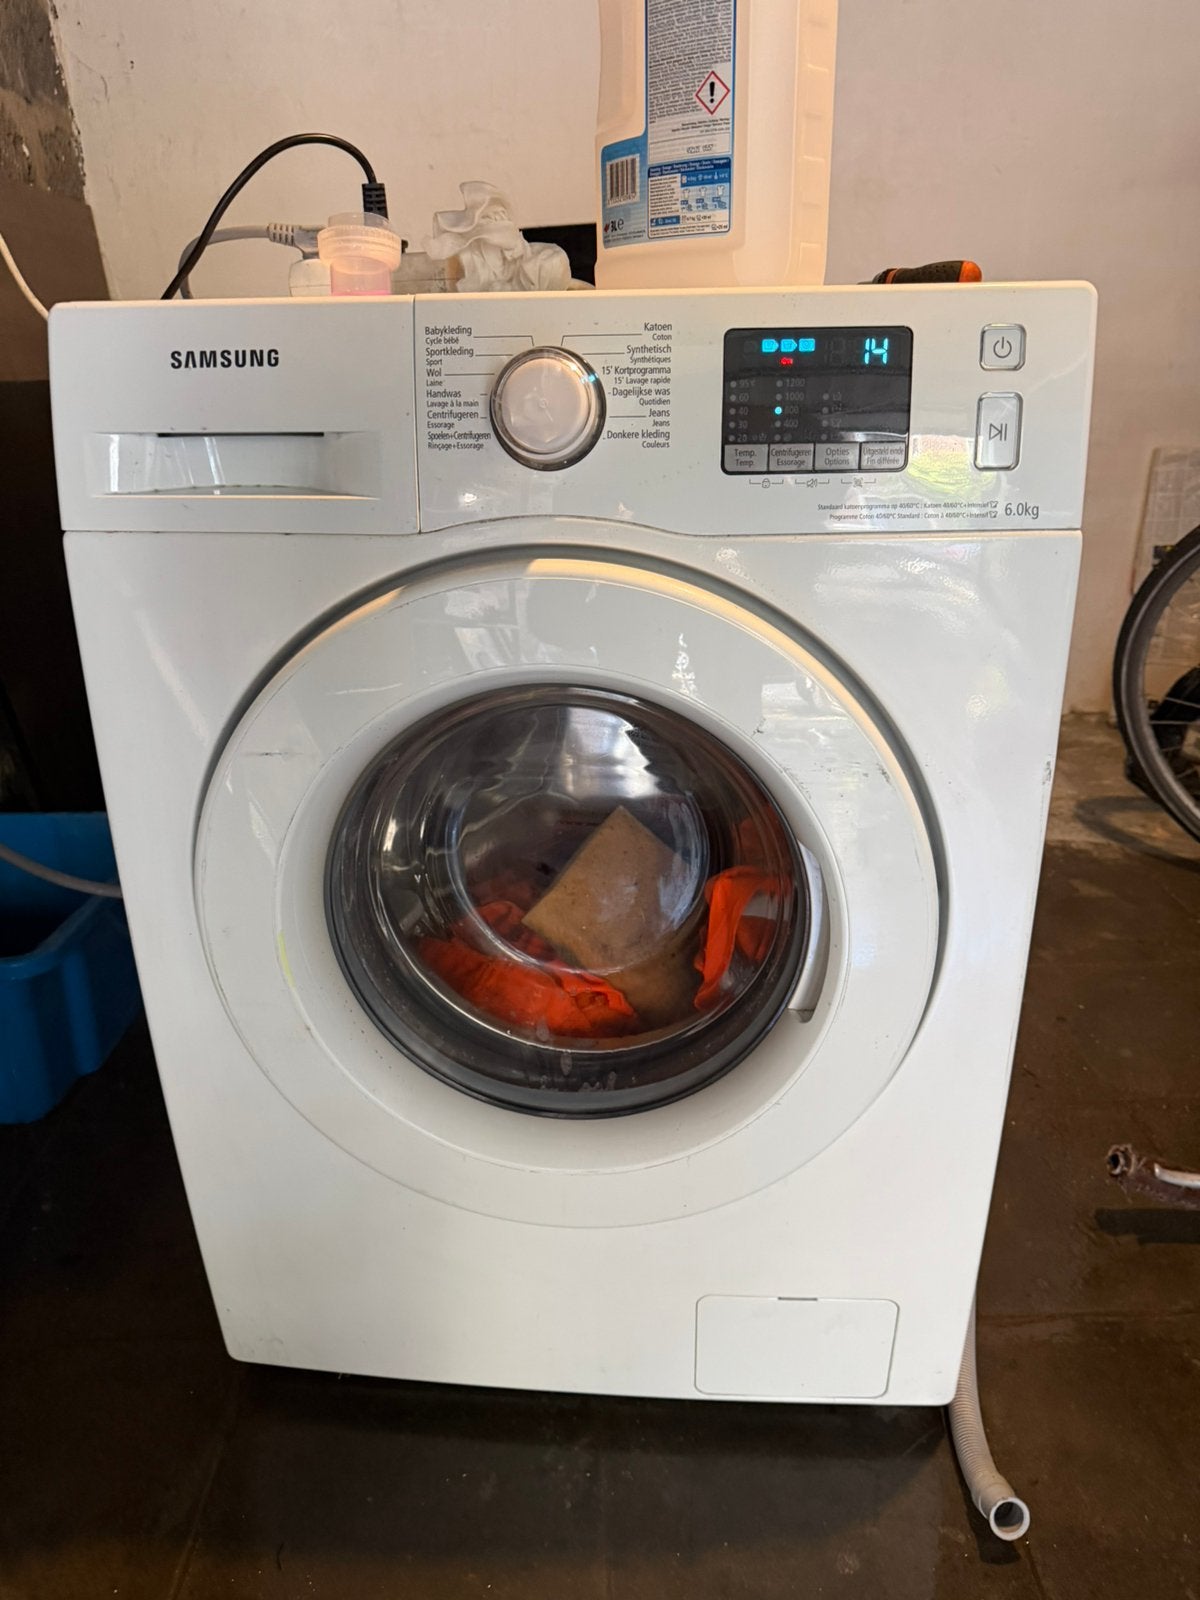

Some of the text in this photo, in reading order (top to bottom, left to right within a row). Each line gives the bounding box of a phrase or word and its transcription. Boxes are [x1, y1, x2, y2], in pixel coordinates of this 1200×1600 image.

[425, 326, 472, 336] Babykleding
[644, 322, 673, 331] Katoen
[425, 336, 460, 346] Cycle bébé
[652, 333, 672, 341] Coton
[425, 347, 474, 358] Sportkleding
[626, 344, 672, 357] Synthetisch
[864, 338, 889, 365] 14
[170, 349, 280, 369] SAMSUNG
[426, 358, 442, 366] Sport
[629, 356, 671, 365] Synthétiques
[426, 368, 442, 377] Wol
[614, 366, 671, 376] Kortprogramma
[426, 379, 443, 387] Laine
[625, 377, 649, 387] Lavage
[650, 376, 671, 386] rapide
[426, 389, 461, 398] Handwas
[612, 387, 671, 398] Dagelijkse was
[426, 400, 449, 409] Lavage
[463, 400, 479, 408] main
[639, 398, 671, 406] Quotidien
[427, 410, 479, 421] Centrifugeren
[649, 408, 671, 418] Jeans
[427, 421, 455, 430] Essorage
[427, 431, 492, 441] Spoelen+Centrifugeren
[607, 429, 671, 440] Donkere kleding
[428, 442, 485, 450] Rinçage+Essorage
[641, 440, 671, 449] Couleurs
[734, 448, 757, 458] Temp.
[825, 447, 850, 458] Opties
[776, 458, 806, 468] Essorage
[824, 458, 850, 468] Options
[866, 457, 876, 465] Fin
[1004, 502, 1040, 519] 6.0kg
[829, 513, 858, 521] Programme
